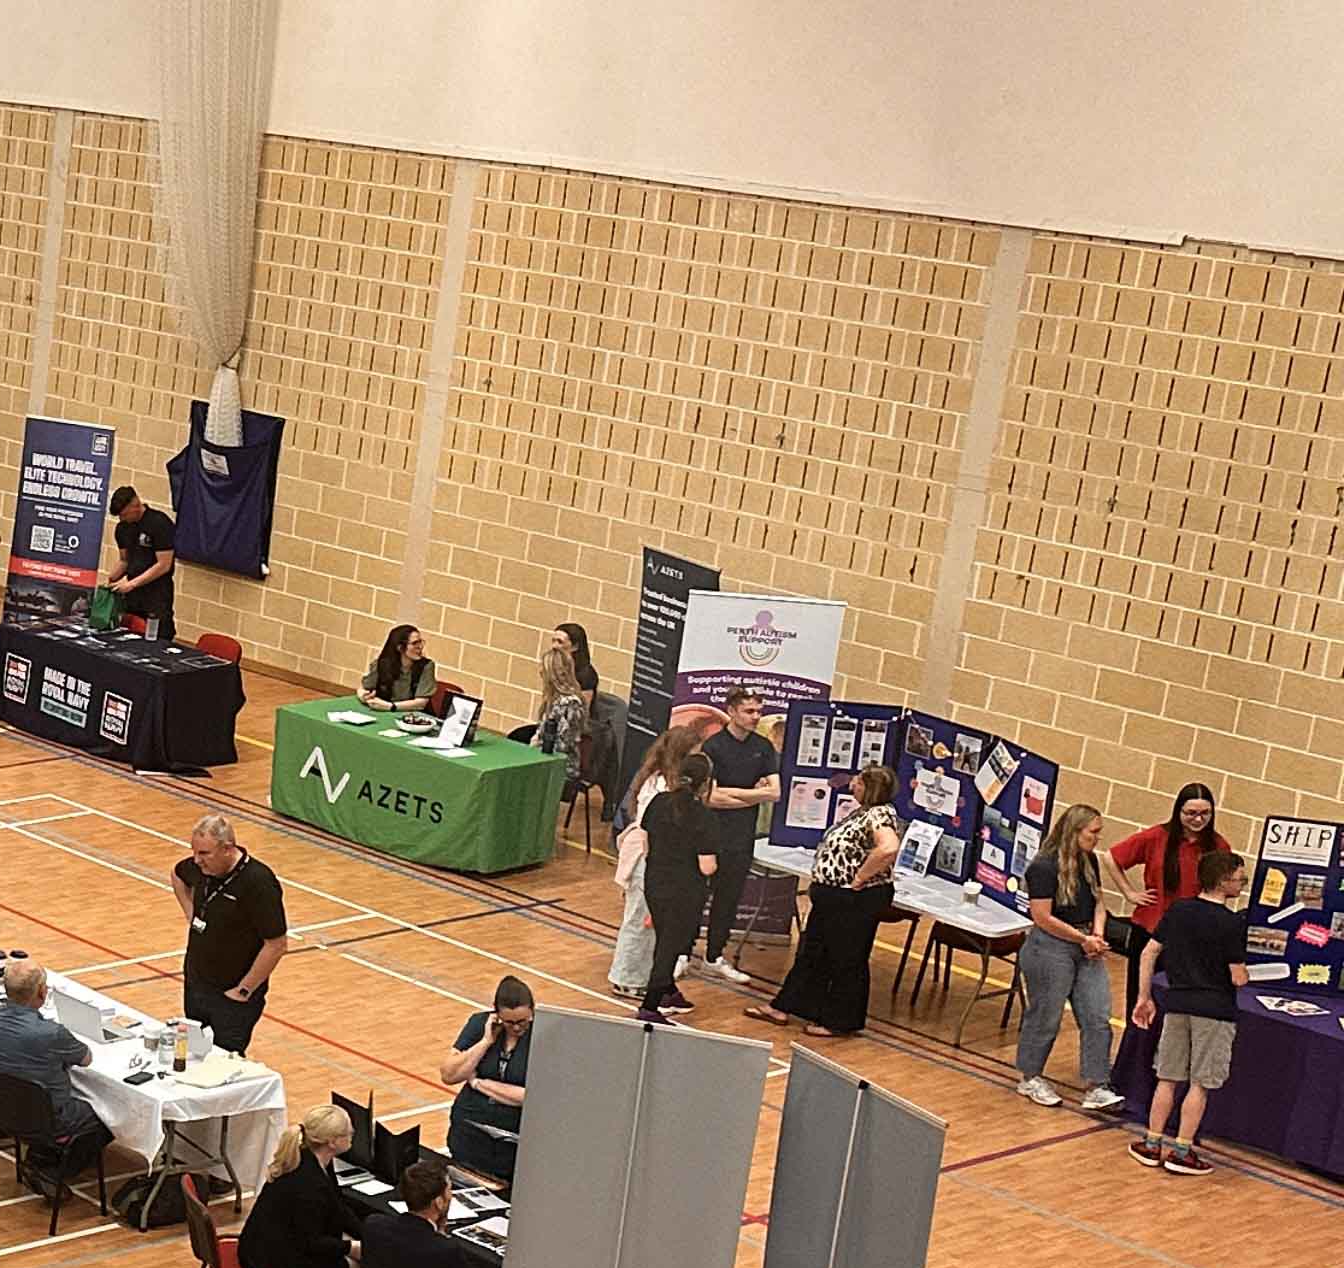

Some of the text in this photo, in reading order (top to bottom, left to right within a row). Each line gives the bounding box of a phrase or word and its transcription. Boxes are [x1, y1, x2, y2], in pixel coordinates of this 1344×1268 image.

[660, 565, 684, 581] AZETS
[726, 625, 799, 640] PERTH AUTISM
[737, 635, 784, 646] SUPPORT
[687, 675, 821, 695] Supporting autistic children
[692, 684, 711, 695] and
[357, 780, 444, 824] AZETS
[1268, 823, 1332, 849] SHIP
